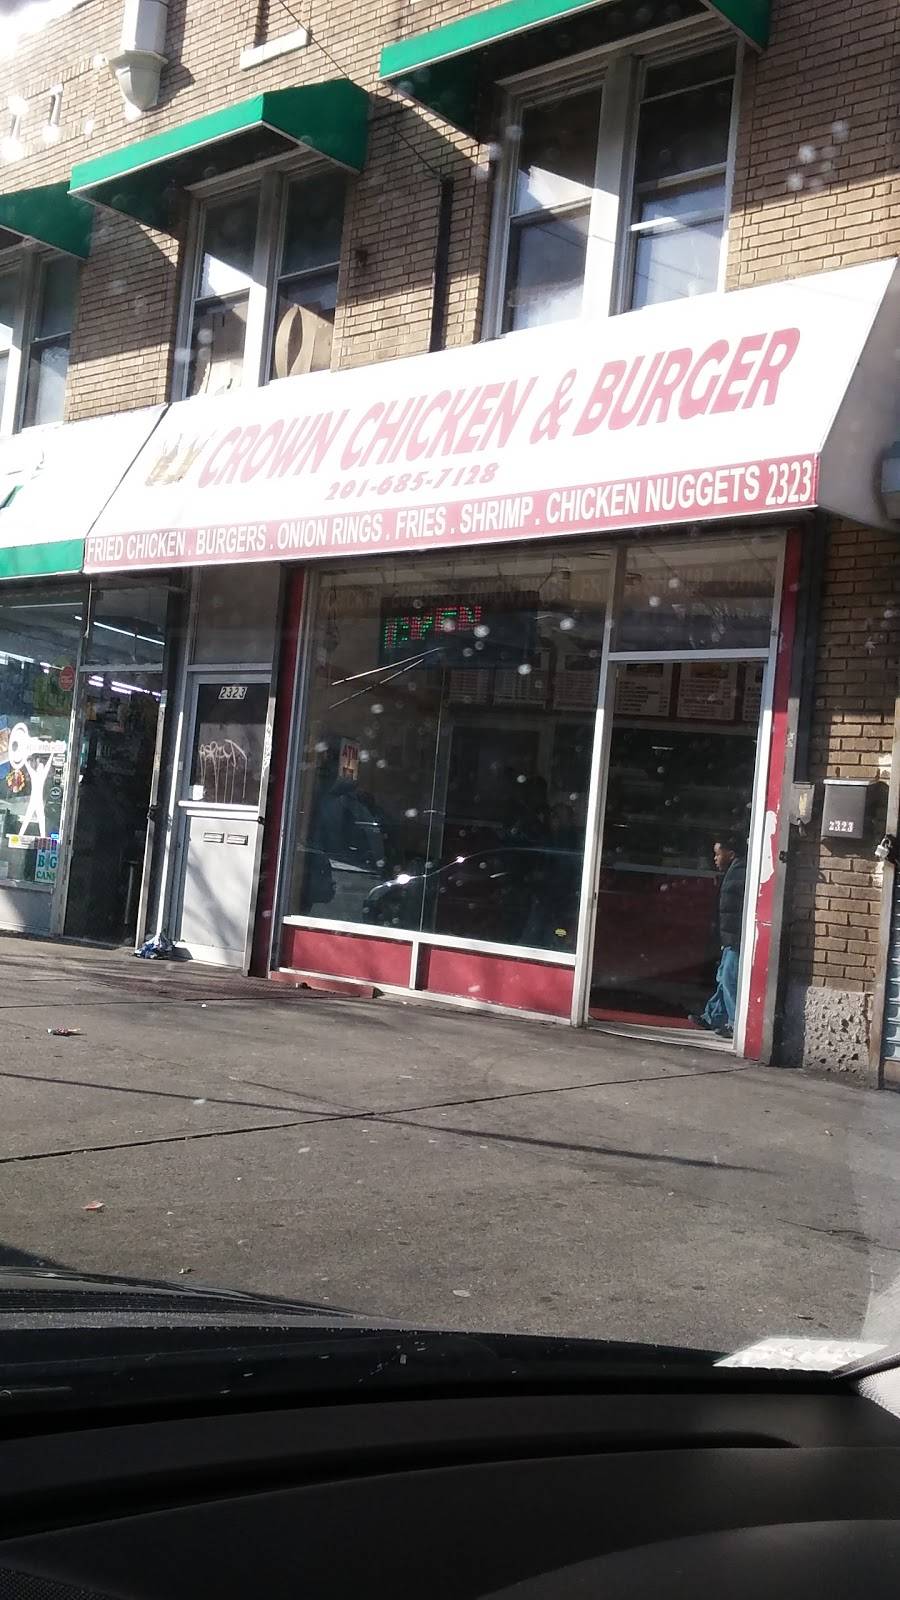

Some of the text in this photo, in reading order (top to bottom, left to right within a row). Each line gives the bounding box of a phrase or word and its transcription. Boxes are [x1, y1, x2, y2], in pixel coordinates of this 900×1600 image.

[197, 328, 801, 488] CROWN CHICKEN & BURGER
[325, 462, 499, 500] 201-685-7128
[87, 459, 812, 562] FRIED CHICKEN BURGERS ONION RINGS FRIES SHRIMP CHICKEN NUGGETS 2323
[219, 687, 248, 700] 2323
[828, 820, 855, 833] 2323
